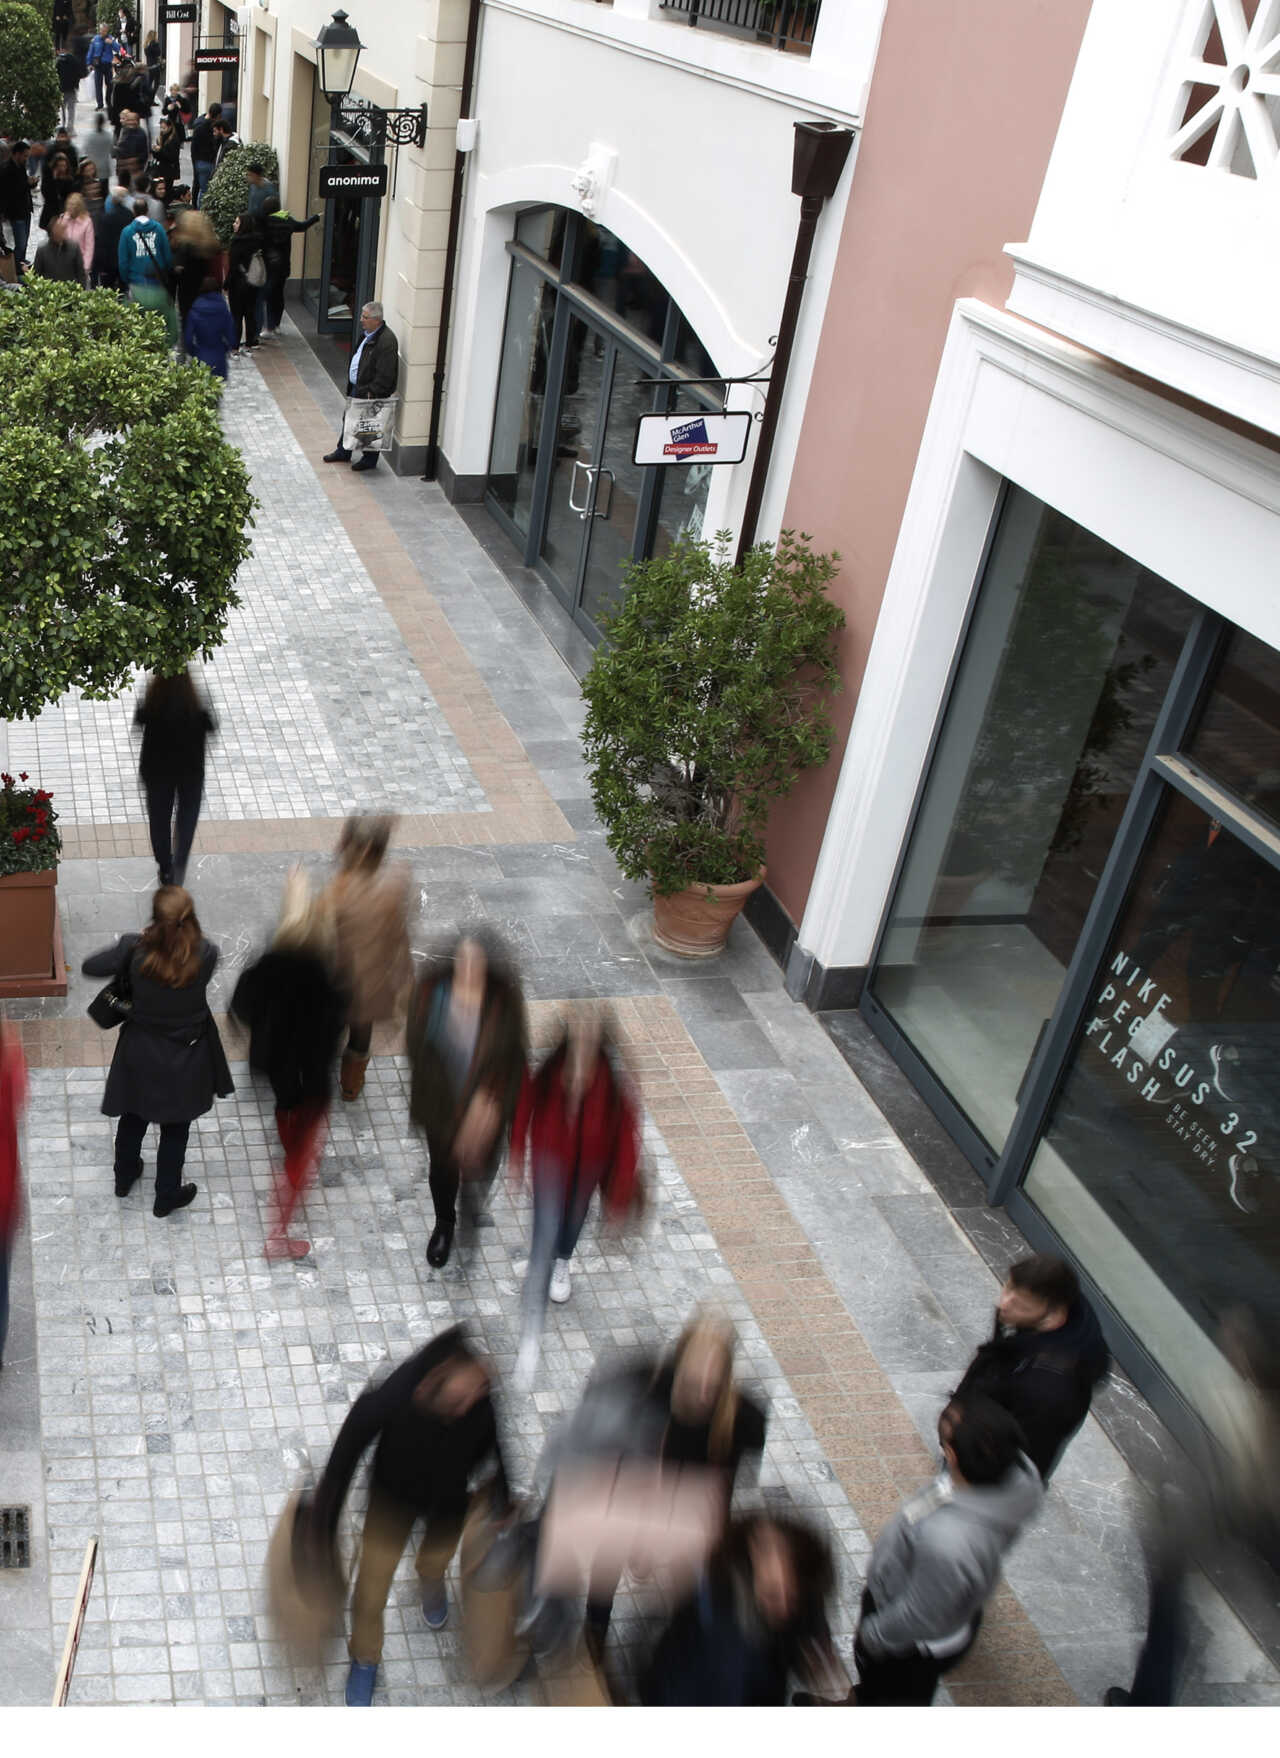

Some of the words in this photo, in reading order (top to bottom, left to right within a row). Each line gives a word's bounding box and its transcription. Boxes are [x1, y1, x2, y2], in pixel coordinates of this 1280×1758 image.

[327, 174, 380, 187] anonima
[672, 420, 704, 437] McArthur
[673, 432, 691, 443] Glen
[664, 446, 693, 454] Designer
[693, 445, 717, 453] Outlets
[1111, 951, 1172, 1014] NIKE
[1086, 1016, 1161, 1101] FLASH
[1098, 983, 1210, 1105] PEGSUS
[1220, 1112, 1257, 1154] 32
[1172, 1103, 1189, 1121] BE
[1166, 1113, 1192, 1141] STAY
